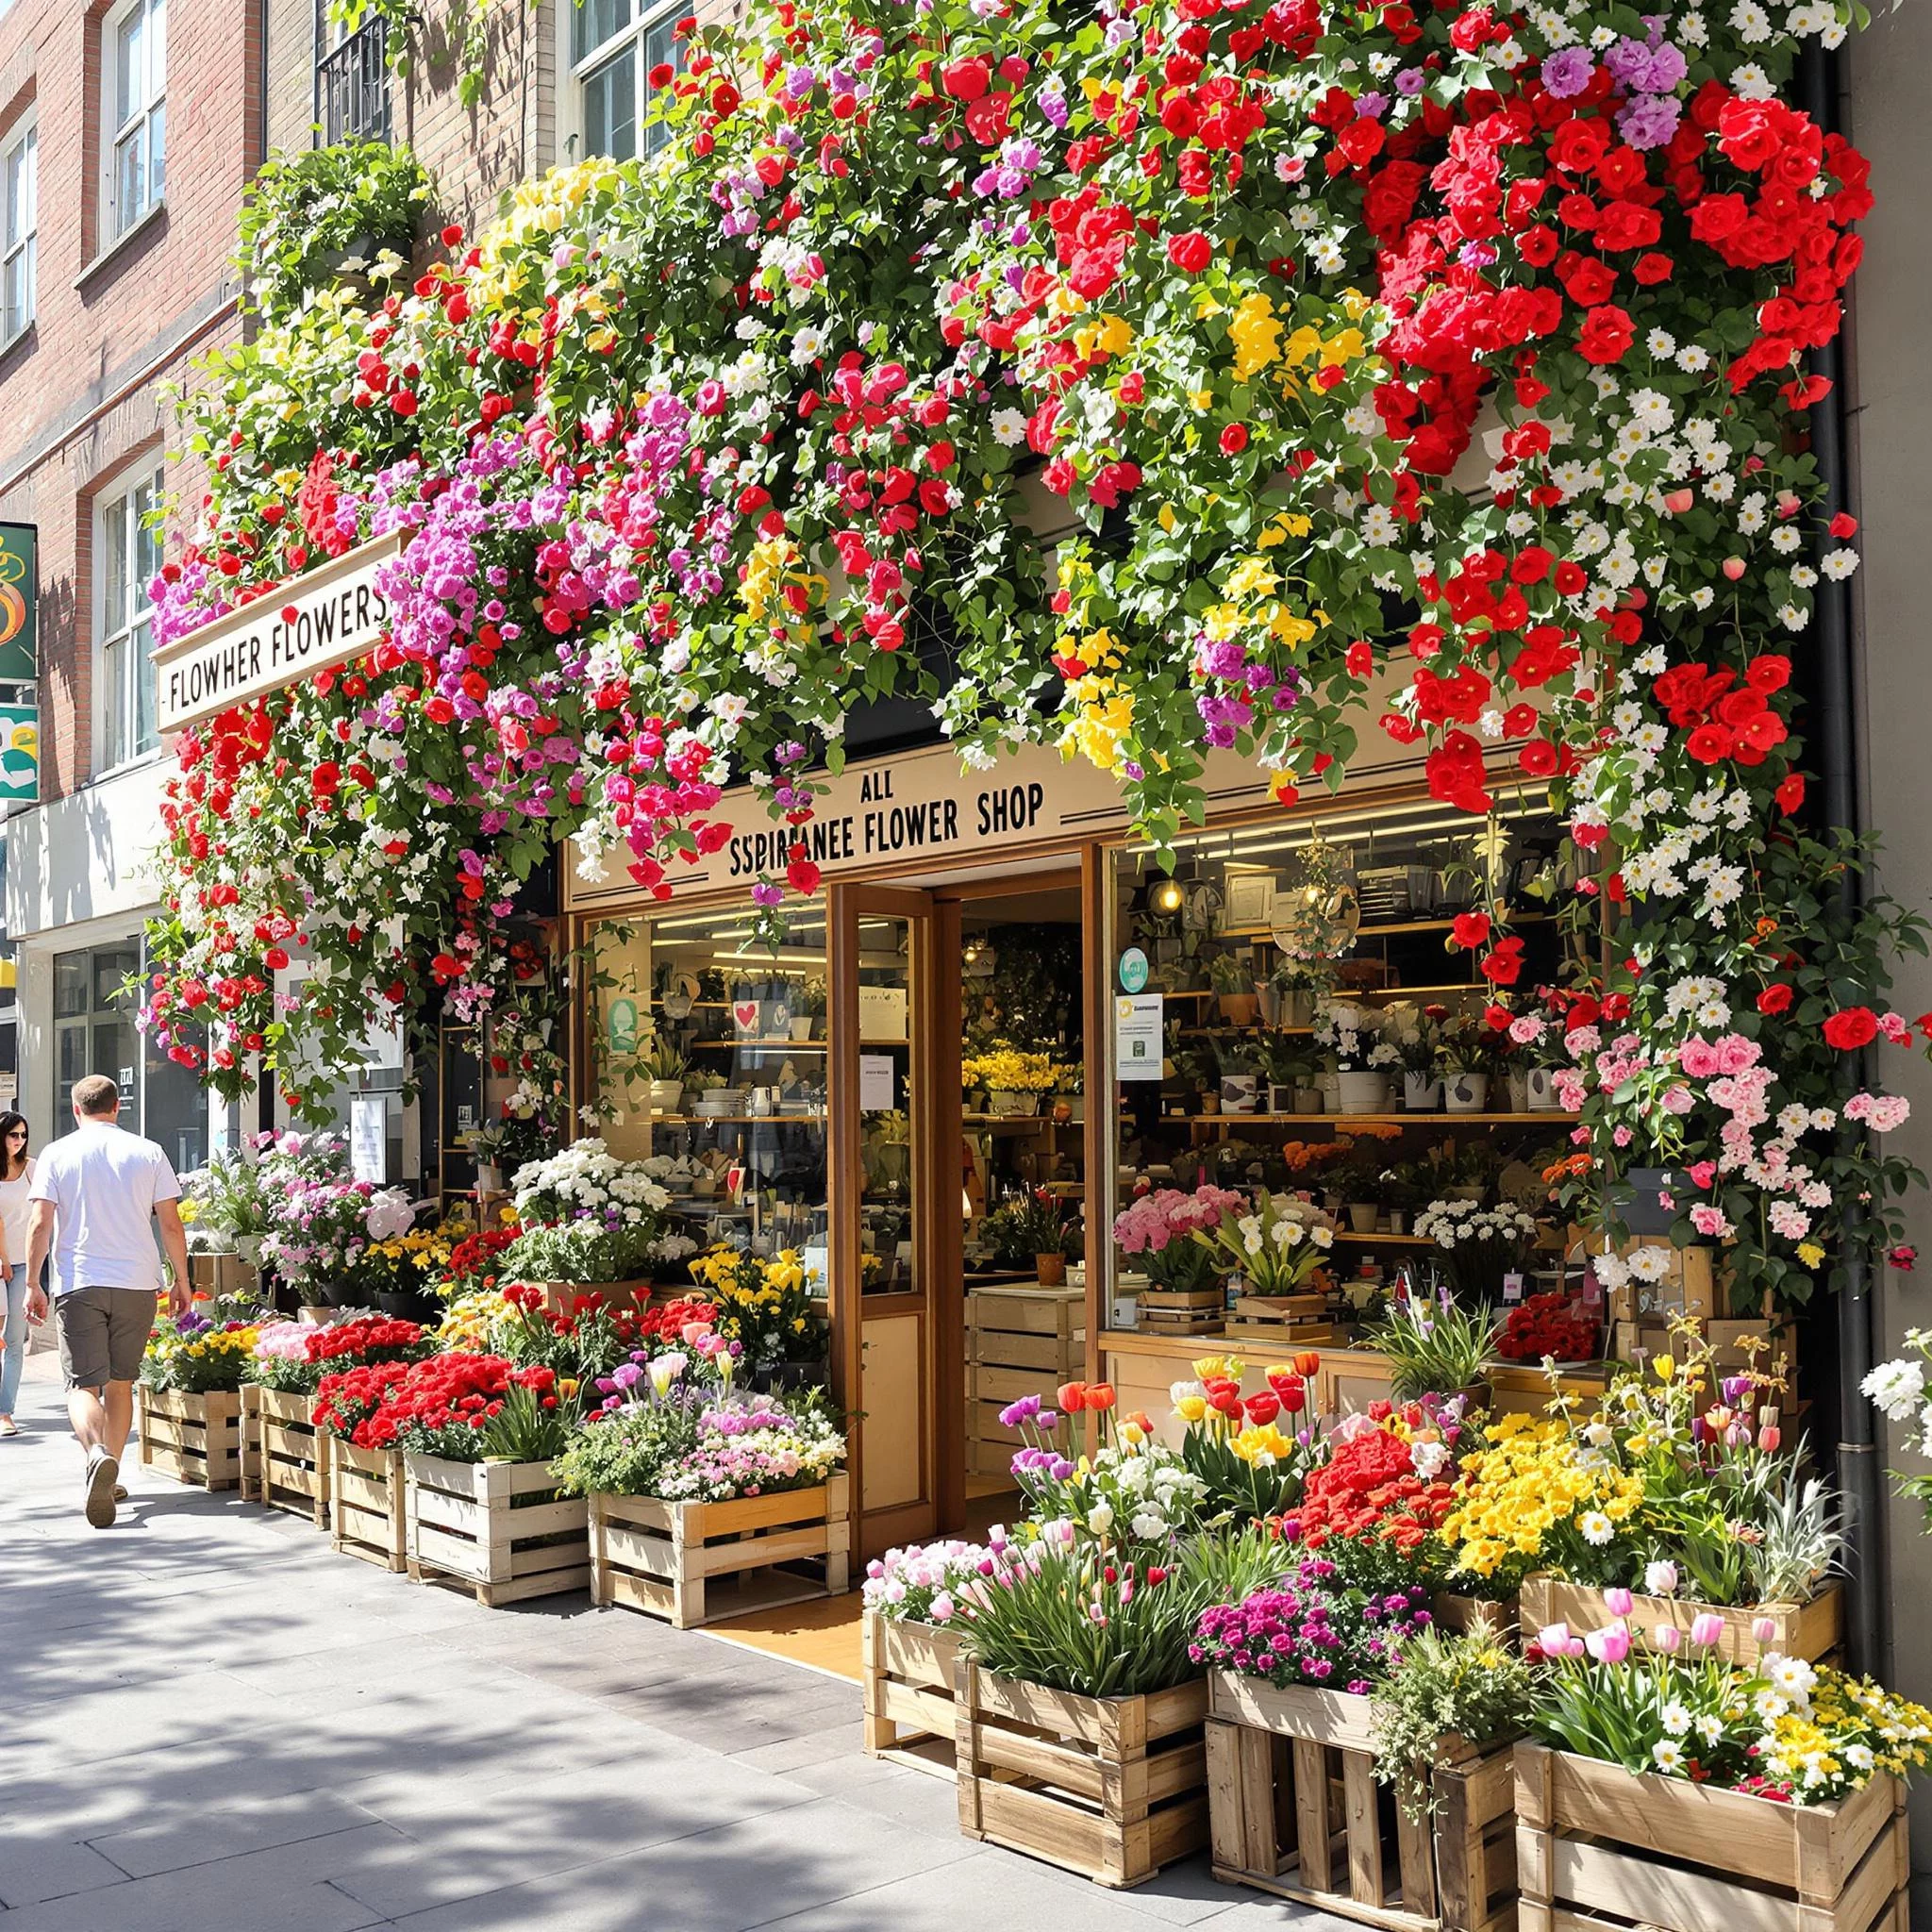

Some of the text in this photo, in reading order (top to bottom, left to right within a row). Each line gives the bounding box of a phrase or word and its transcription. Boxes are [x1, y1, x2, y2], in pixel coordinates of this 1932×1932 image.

[171, 584, 387, 712] FLOWHER FLOWERS
[860, 770, 894, 803] ALL
[865, 799, 958, 854] FLOWER
[976, 783, 1044, 836] SHOP
